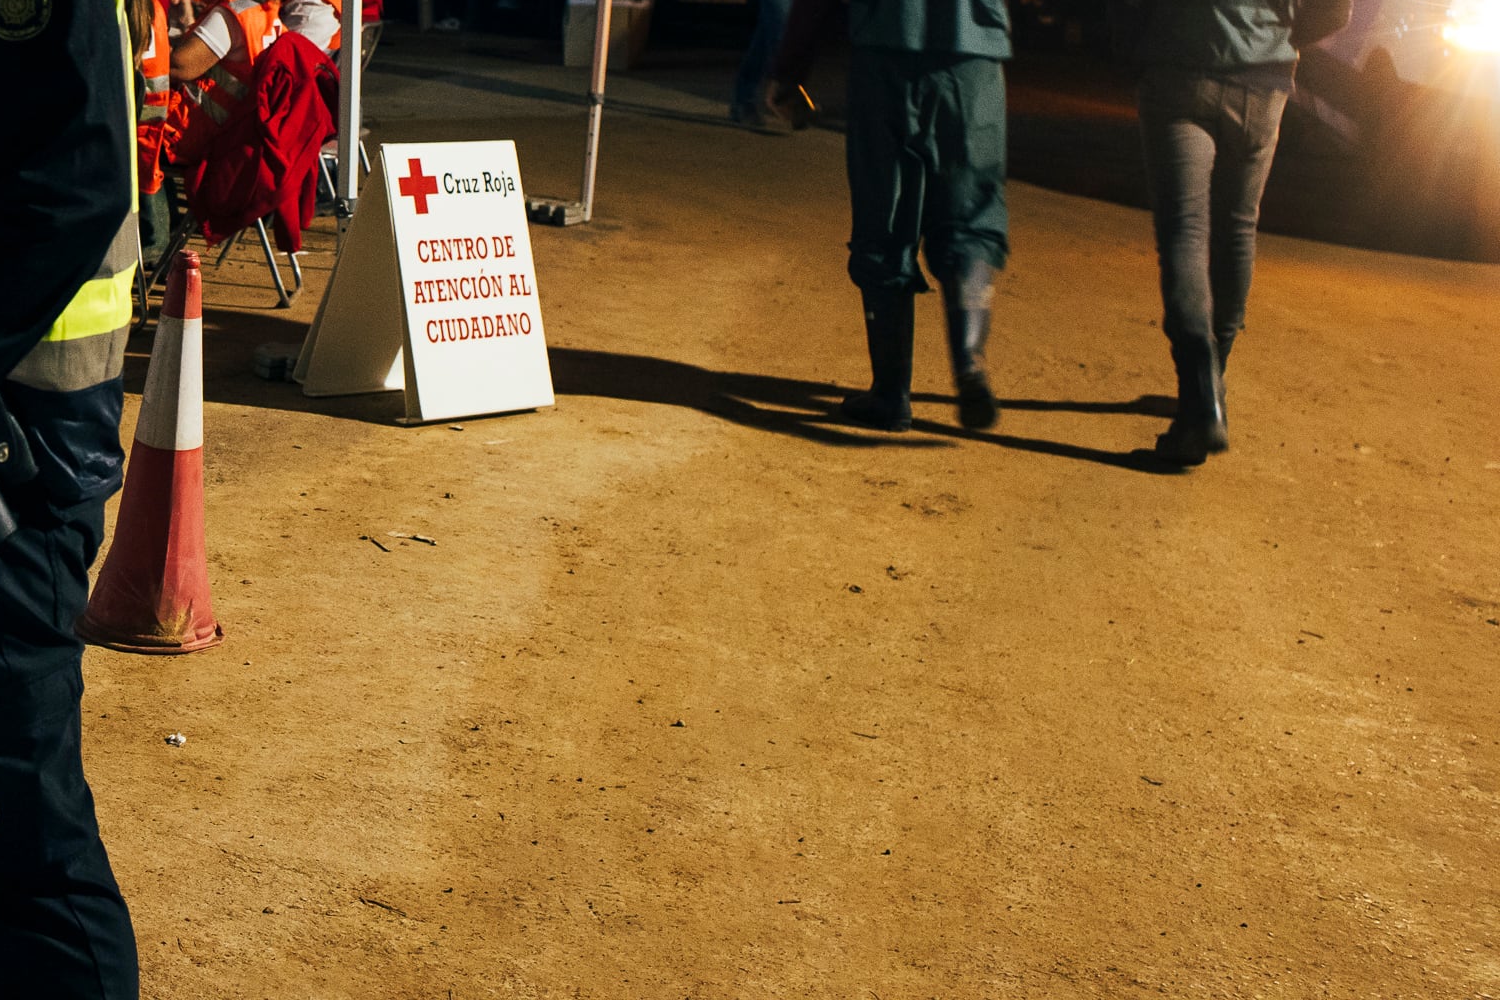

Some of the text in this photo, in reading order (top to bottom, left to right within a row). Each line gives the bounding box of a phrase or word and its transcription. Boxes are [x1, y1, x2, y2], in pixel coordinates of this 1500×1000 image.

[443, 171, 515, 197] Cruz Roja
[417, 235, 516, 263] CENTRO DE
[414, 268, 531, 304] ATENCIÓN AL
[426, 312, 532, 343] CIUDADANO
